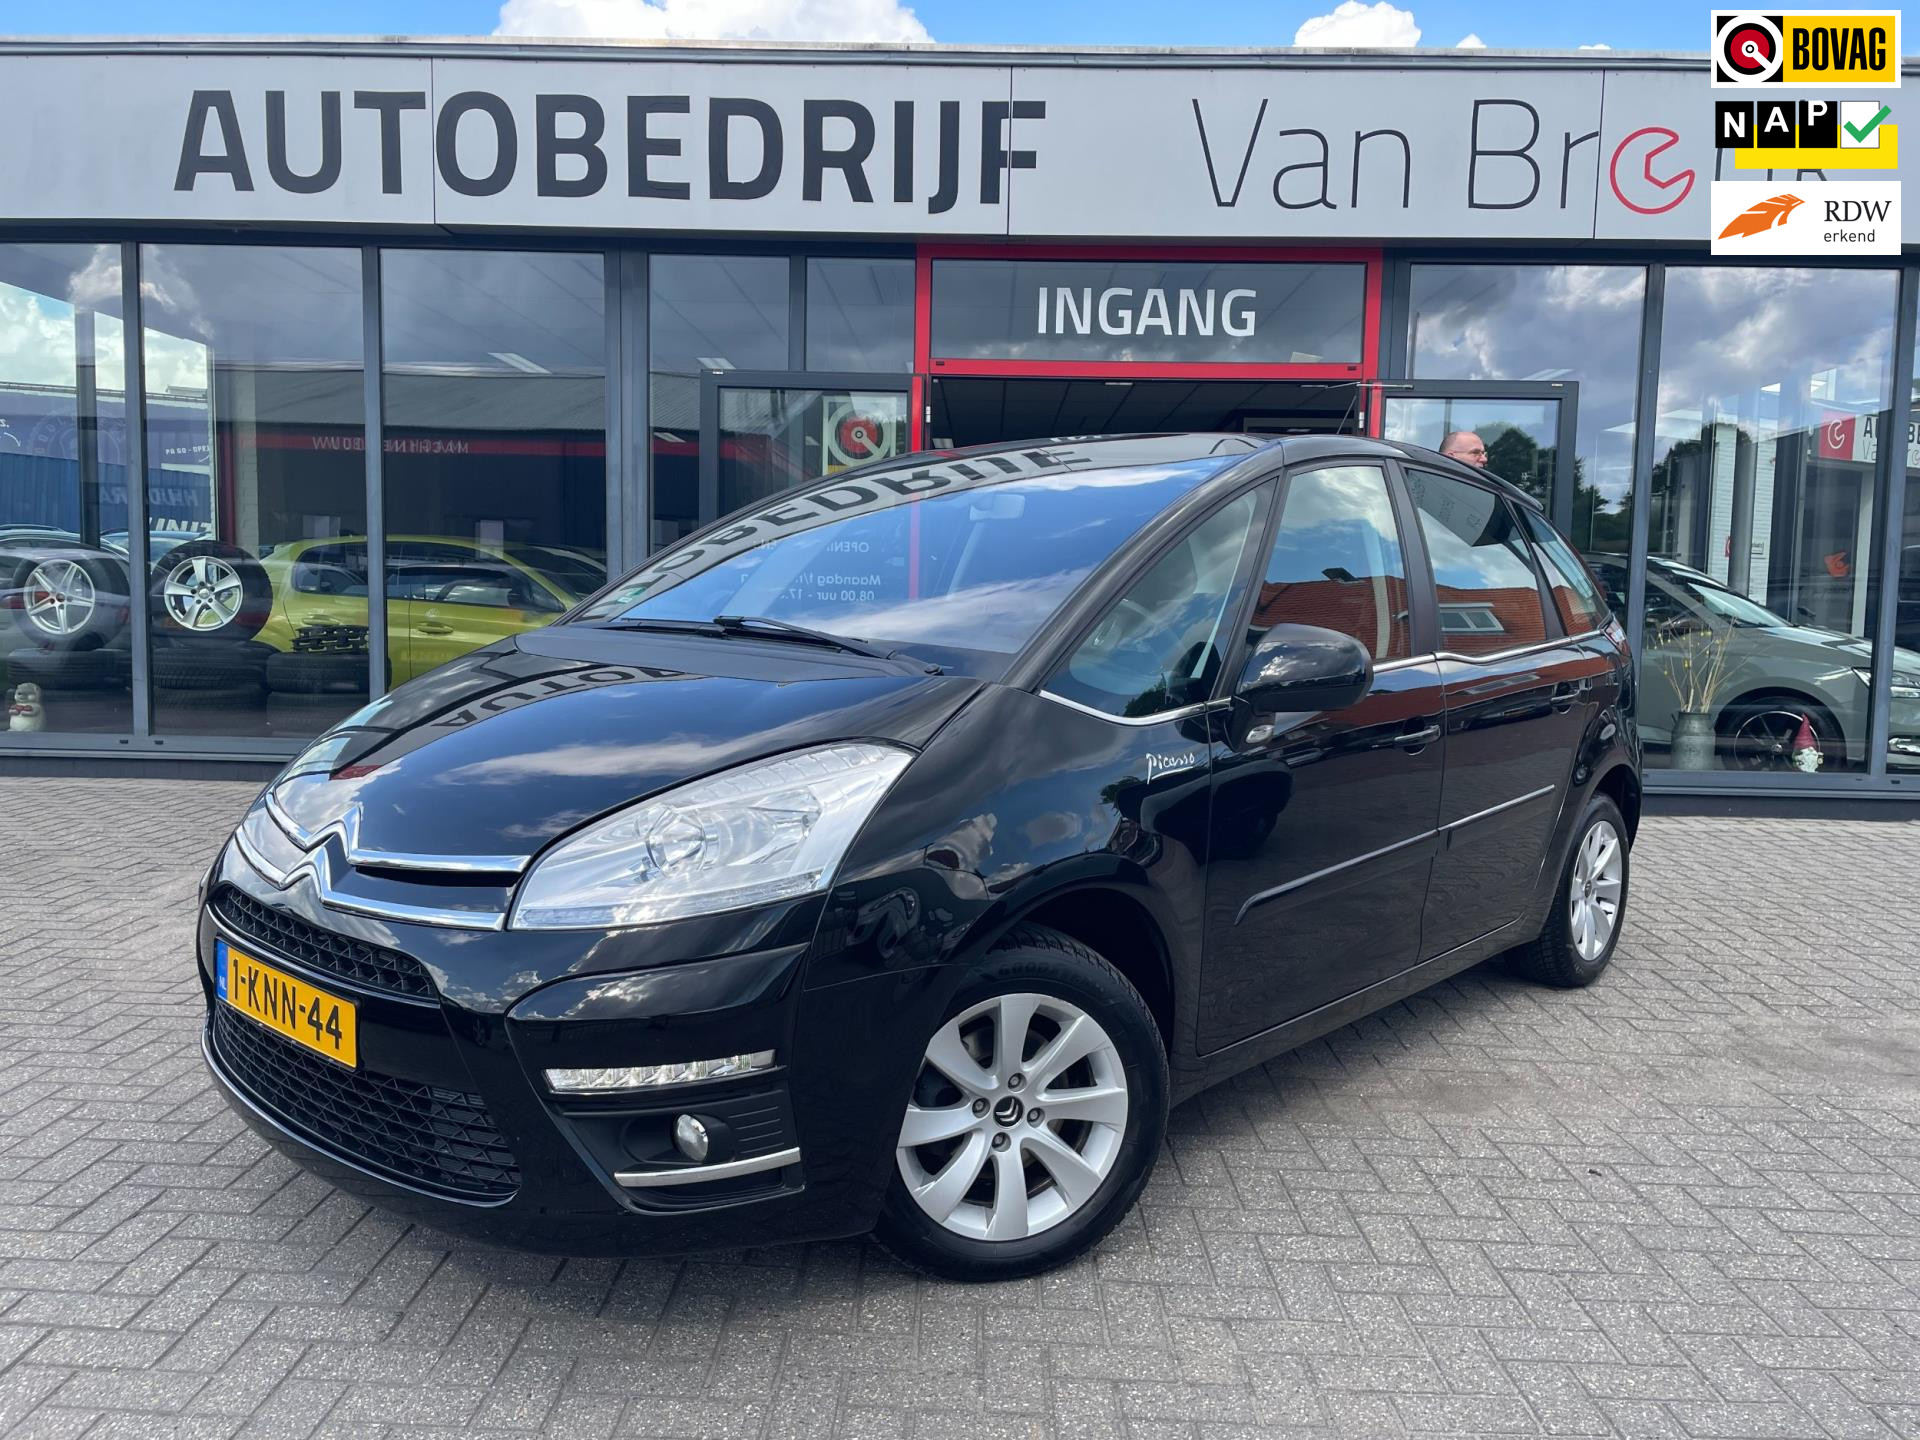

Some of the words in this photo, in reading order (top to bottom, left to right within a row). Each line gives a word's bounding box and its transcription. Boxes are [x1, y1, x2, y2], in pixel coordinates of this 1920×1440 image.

[174, 90, 1046, 215] AUTOBEDRIJF
[1192, 98, 1411, 210] Van
[1038, 286, 1257, 337] INGANG
[1145, 752, 1195, 785] Picasso
[219, 975, 227, 991] NL
[232, 957, 343, 1051] 1-KNN-44
